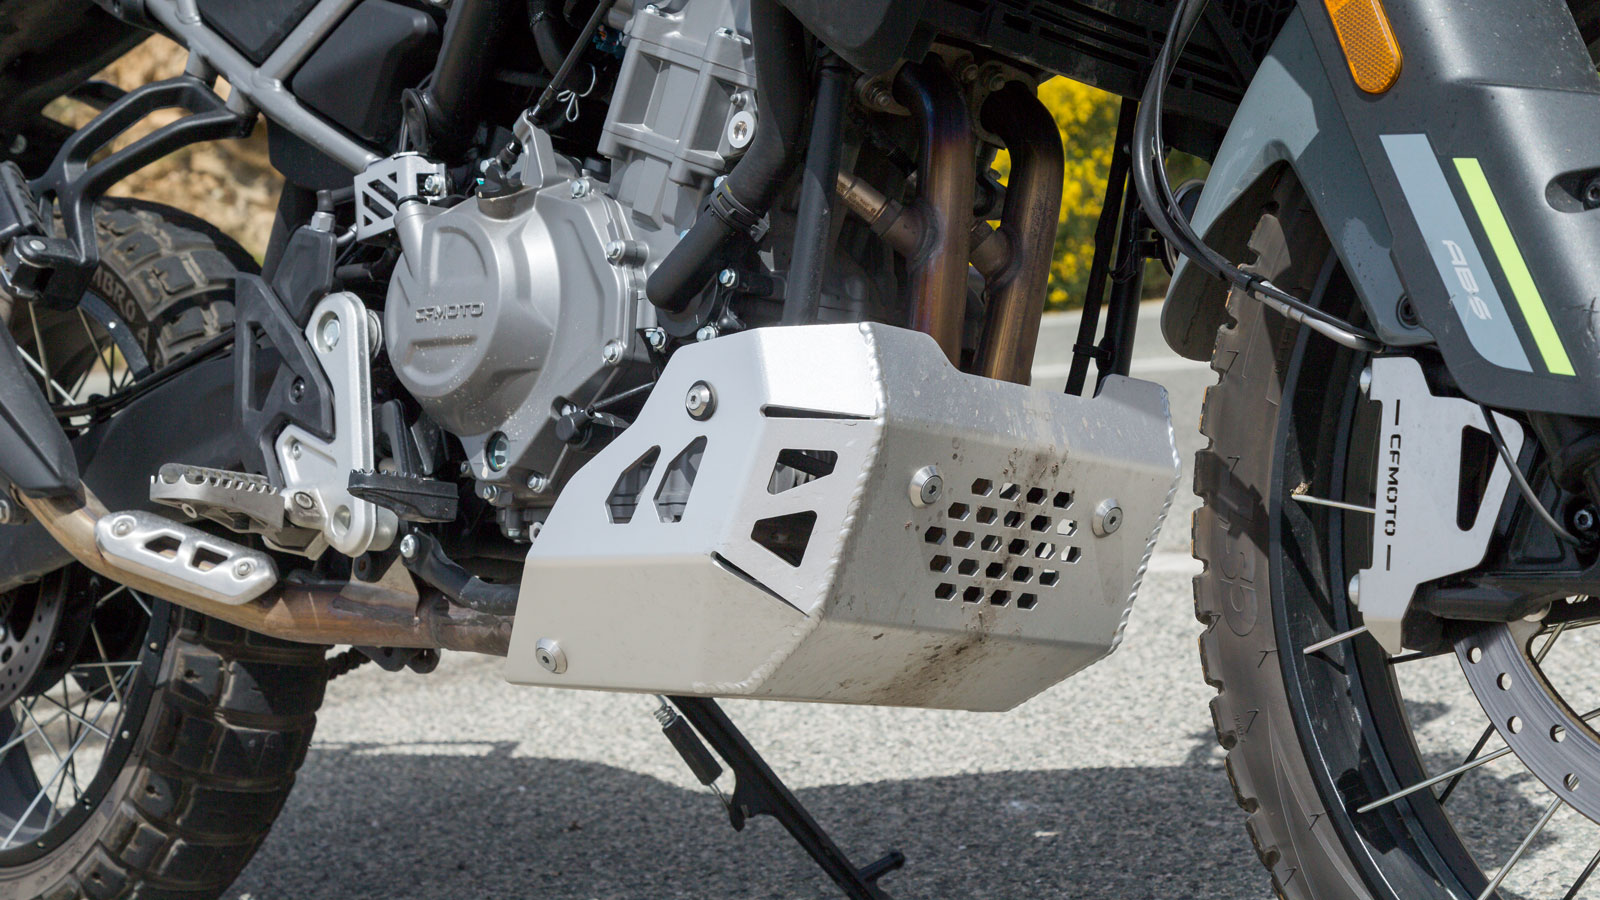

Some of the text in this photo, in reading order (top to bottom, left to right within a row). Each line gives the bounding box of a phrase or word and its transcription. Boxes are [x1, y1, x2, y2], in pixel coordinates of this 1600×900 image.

[415, 302, 485, 323] CFMOTO
[1441, 240, 1493, 320] ABS
[1385, 433, 1402, 537] CFMOTO
